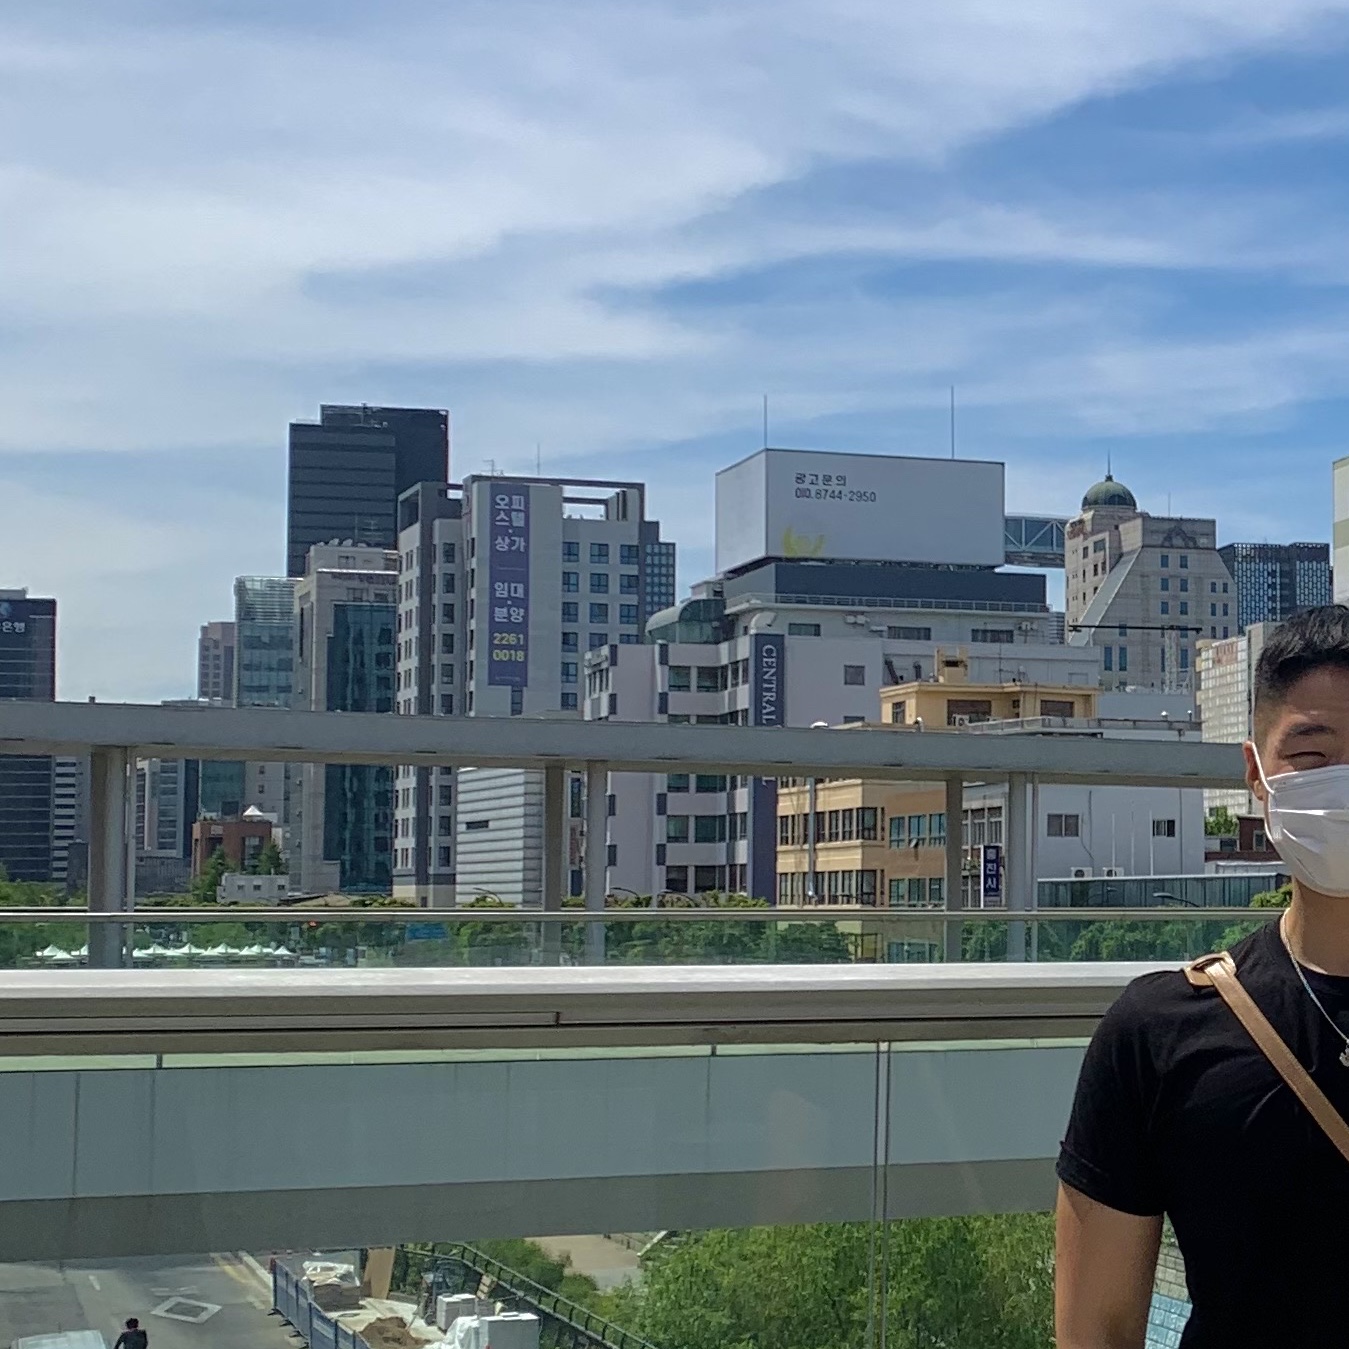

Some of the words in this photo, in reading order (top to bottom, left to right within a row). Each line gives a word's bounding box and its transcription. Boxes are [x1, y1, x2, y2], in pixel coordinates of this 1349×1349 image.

[795, 472, 846, 487] 광고문의
[495, 494, 524, 510] 오피
[495, 536, 525, 552] 상가
[494, 582, 524, 598] 임대
[494, 606, 524, 623] 분양
[0, 621, 26, 633] 은행
[493, 632, 524, 645] 2261
[492, 650, 525, 662] 0018
[761, 644, 777, 725] CENTRAL
